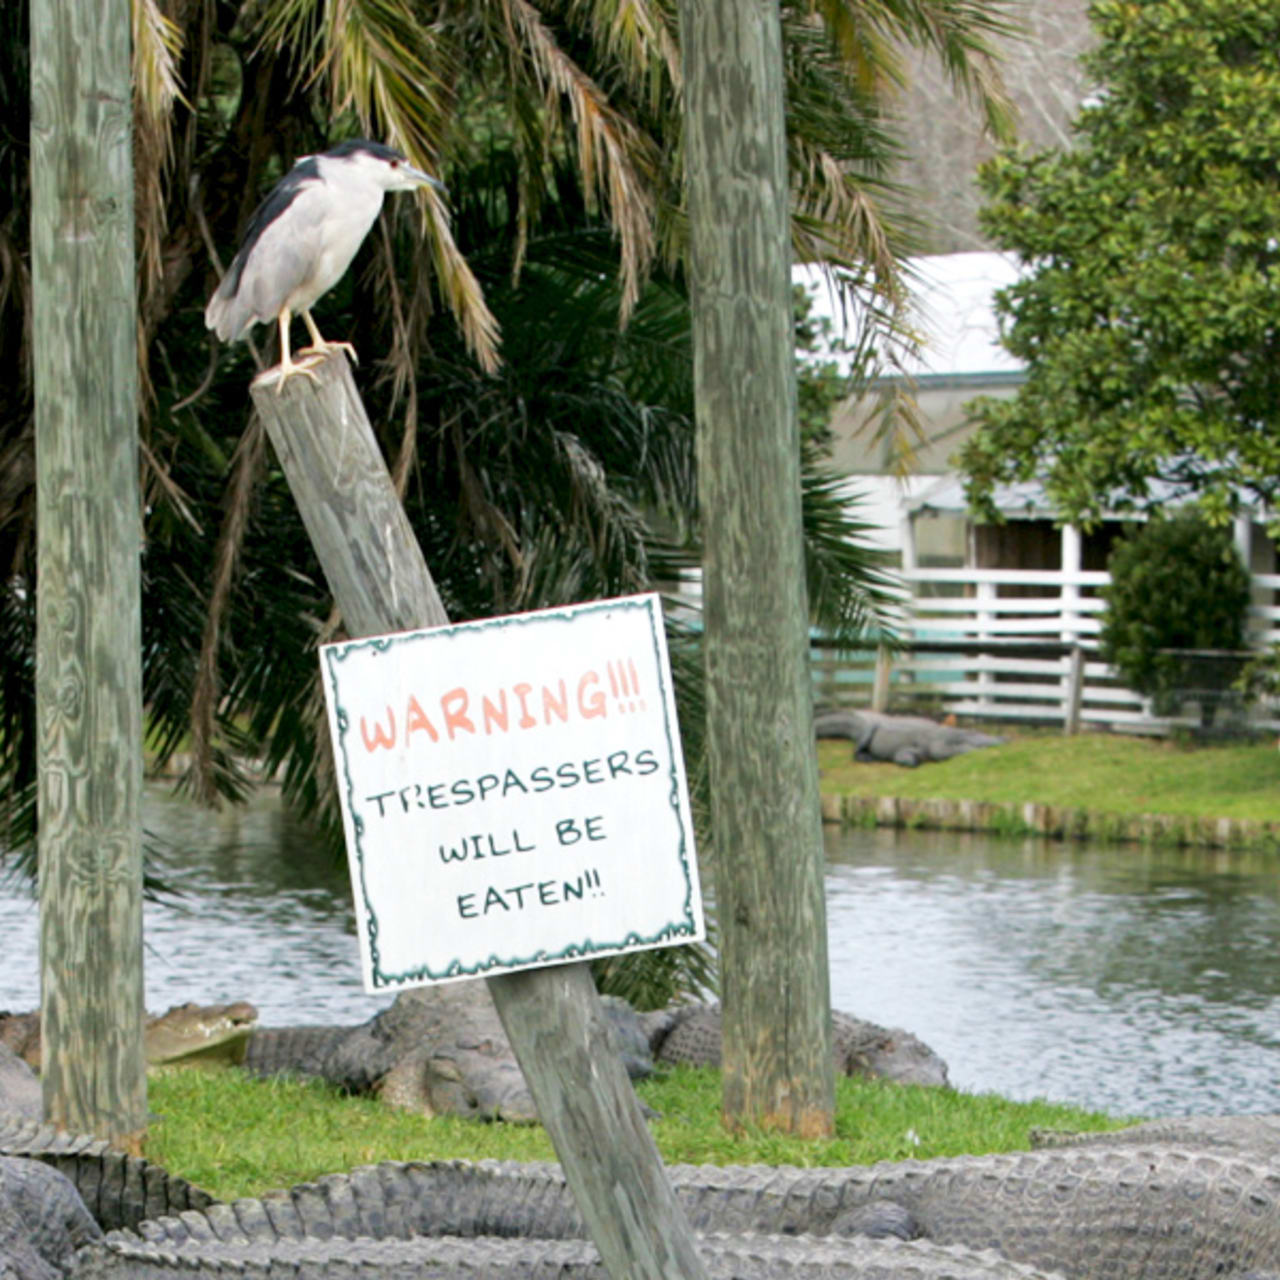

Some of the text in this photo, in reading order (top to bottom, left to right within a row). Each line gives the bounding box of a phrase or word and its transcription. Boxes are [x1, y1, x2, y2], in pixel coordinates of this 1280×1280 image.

[359, 657, 647, 753] WARNING!!!
[365, 750, 660, 817] TRESPASSERS
[439, 816, 607, 863] WILL BE
[457, 869, 606, 919] EATEN!!
